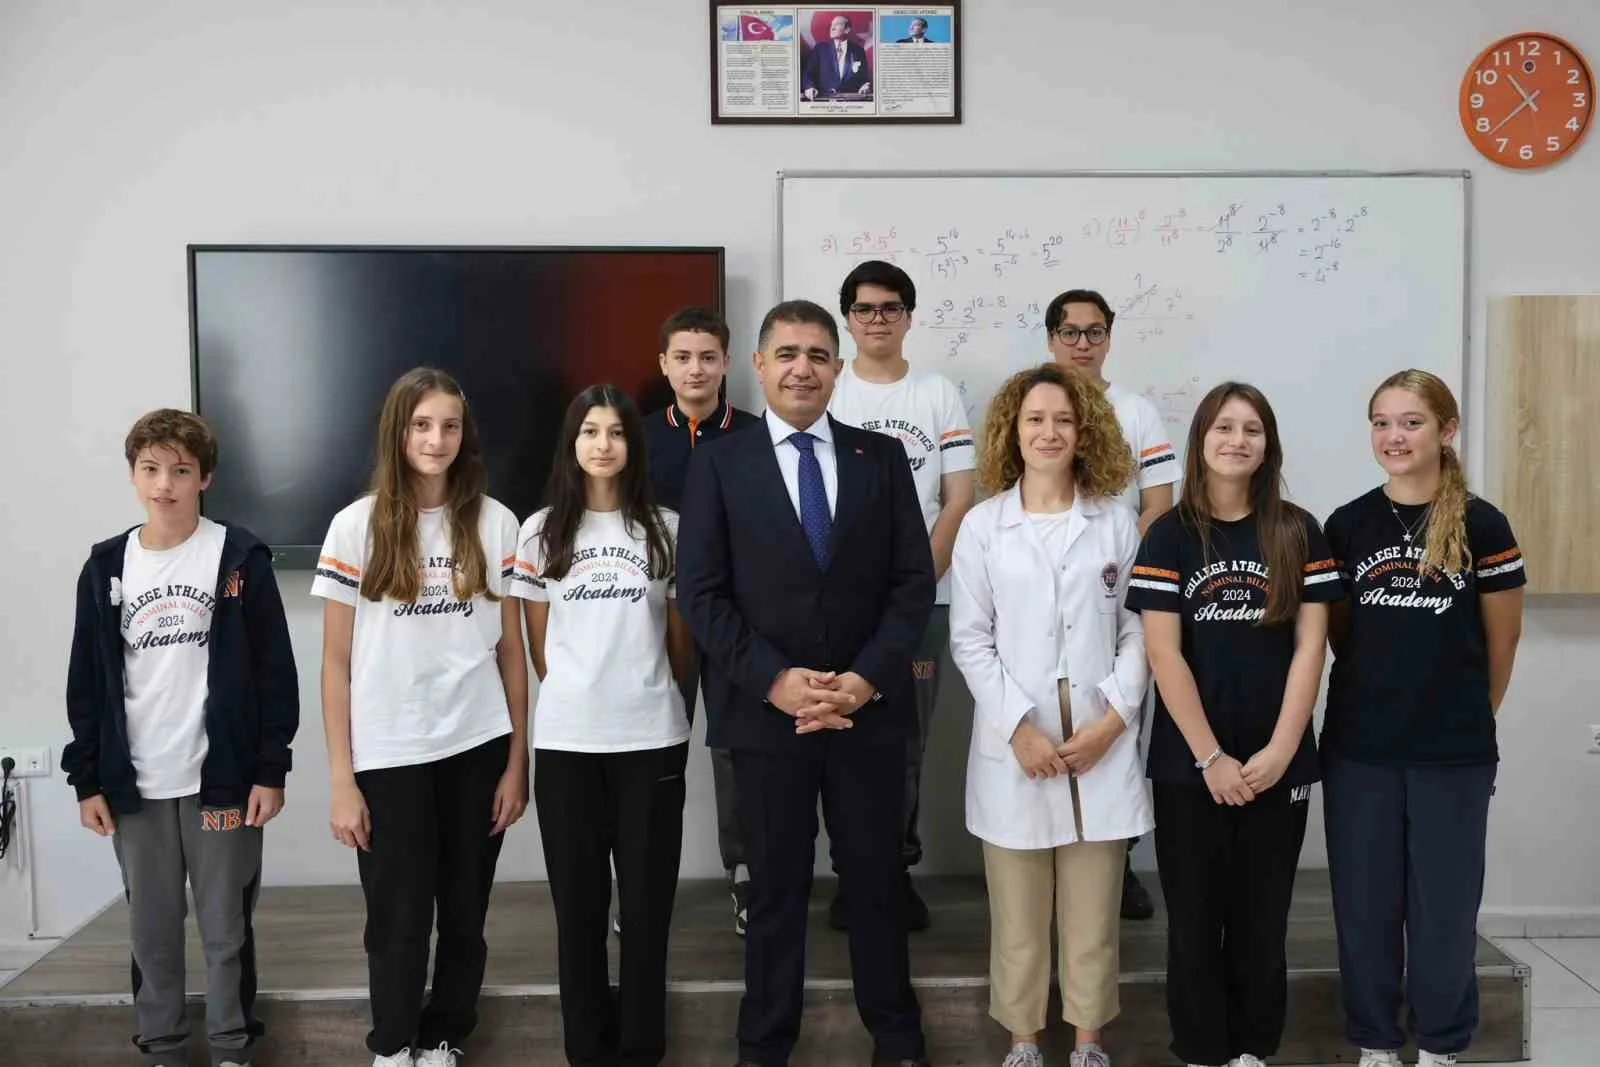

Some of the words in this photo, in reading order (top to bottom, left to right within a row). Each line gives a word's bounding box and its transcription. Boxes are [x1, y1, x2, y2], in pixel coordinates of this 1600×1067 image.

[1518, 41, 1541, 56] 12
[1493, 51, 1511, 66] 11
[1553, 51, 1561, 65] 1
[1475, 69, 1498, 86] 10
[1567, 69, 1580, 84] 2
[1470, 93, 1484, 108] 9
[1572, 92, 1586, 107] 3
[1476, 117, 1490, 132] 8
[1565, 117, 1579, 131] 4
[1496, 138, 1509, 152] 7
[1546, 136, 1560, 151] 5
[1520, 145, 1533, 160] 6
[884, 419, 935, 452] ATHLETICS
[601, 546, 651, 576] ATHLETIC
[591, 572, 619, 583] 2024
[1367, 560, 1414, 581] NOMINAL
[1184, 560, 1228, 599] COLLEGE
[1201, 576, 1244, 597] NOMINAL
[1391, 576, 1421, 588] 2024
[421, 585, 449, 597] 2024
[563, 584, 647, 603] Academy
[1222, 589, 1251, 601] 2024
[393, 598, 474, 618] Academy
[1360, 587, 1453, 615] Academy
[157, 614, 185, 628] 2024
[133, 628, 210, 650] Academy
[200, 809, 241, 832] NB
